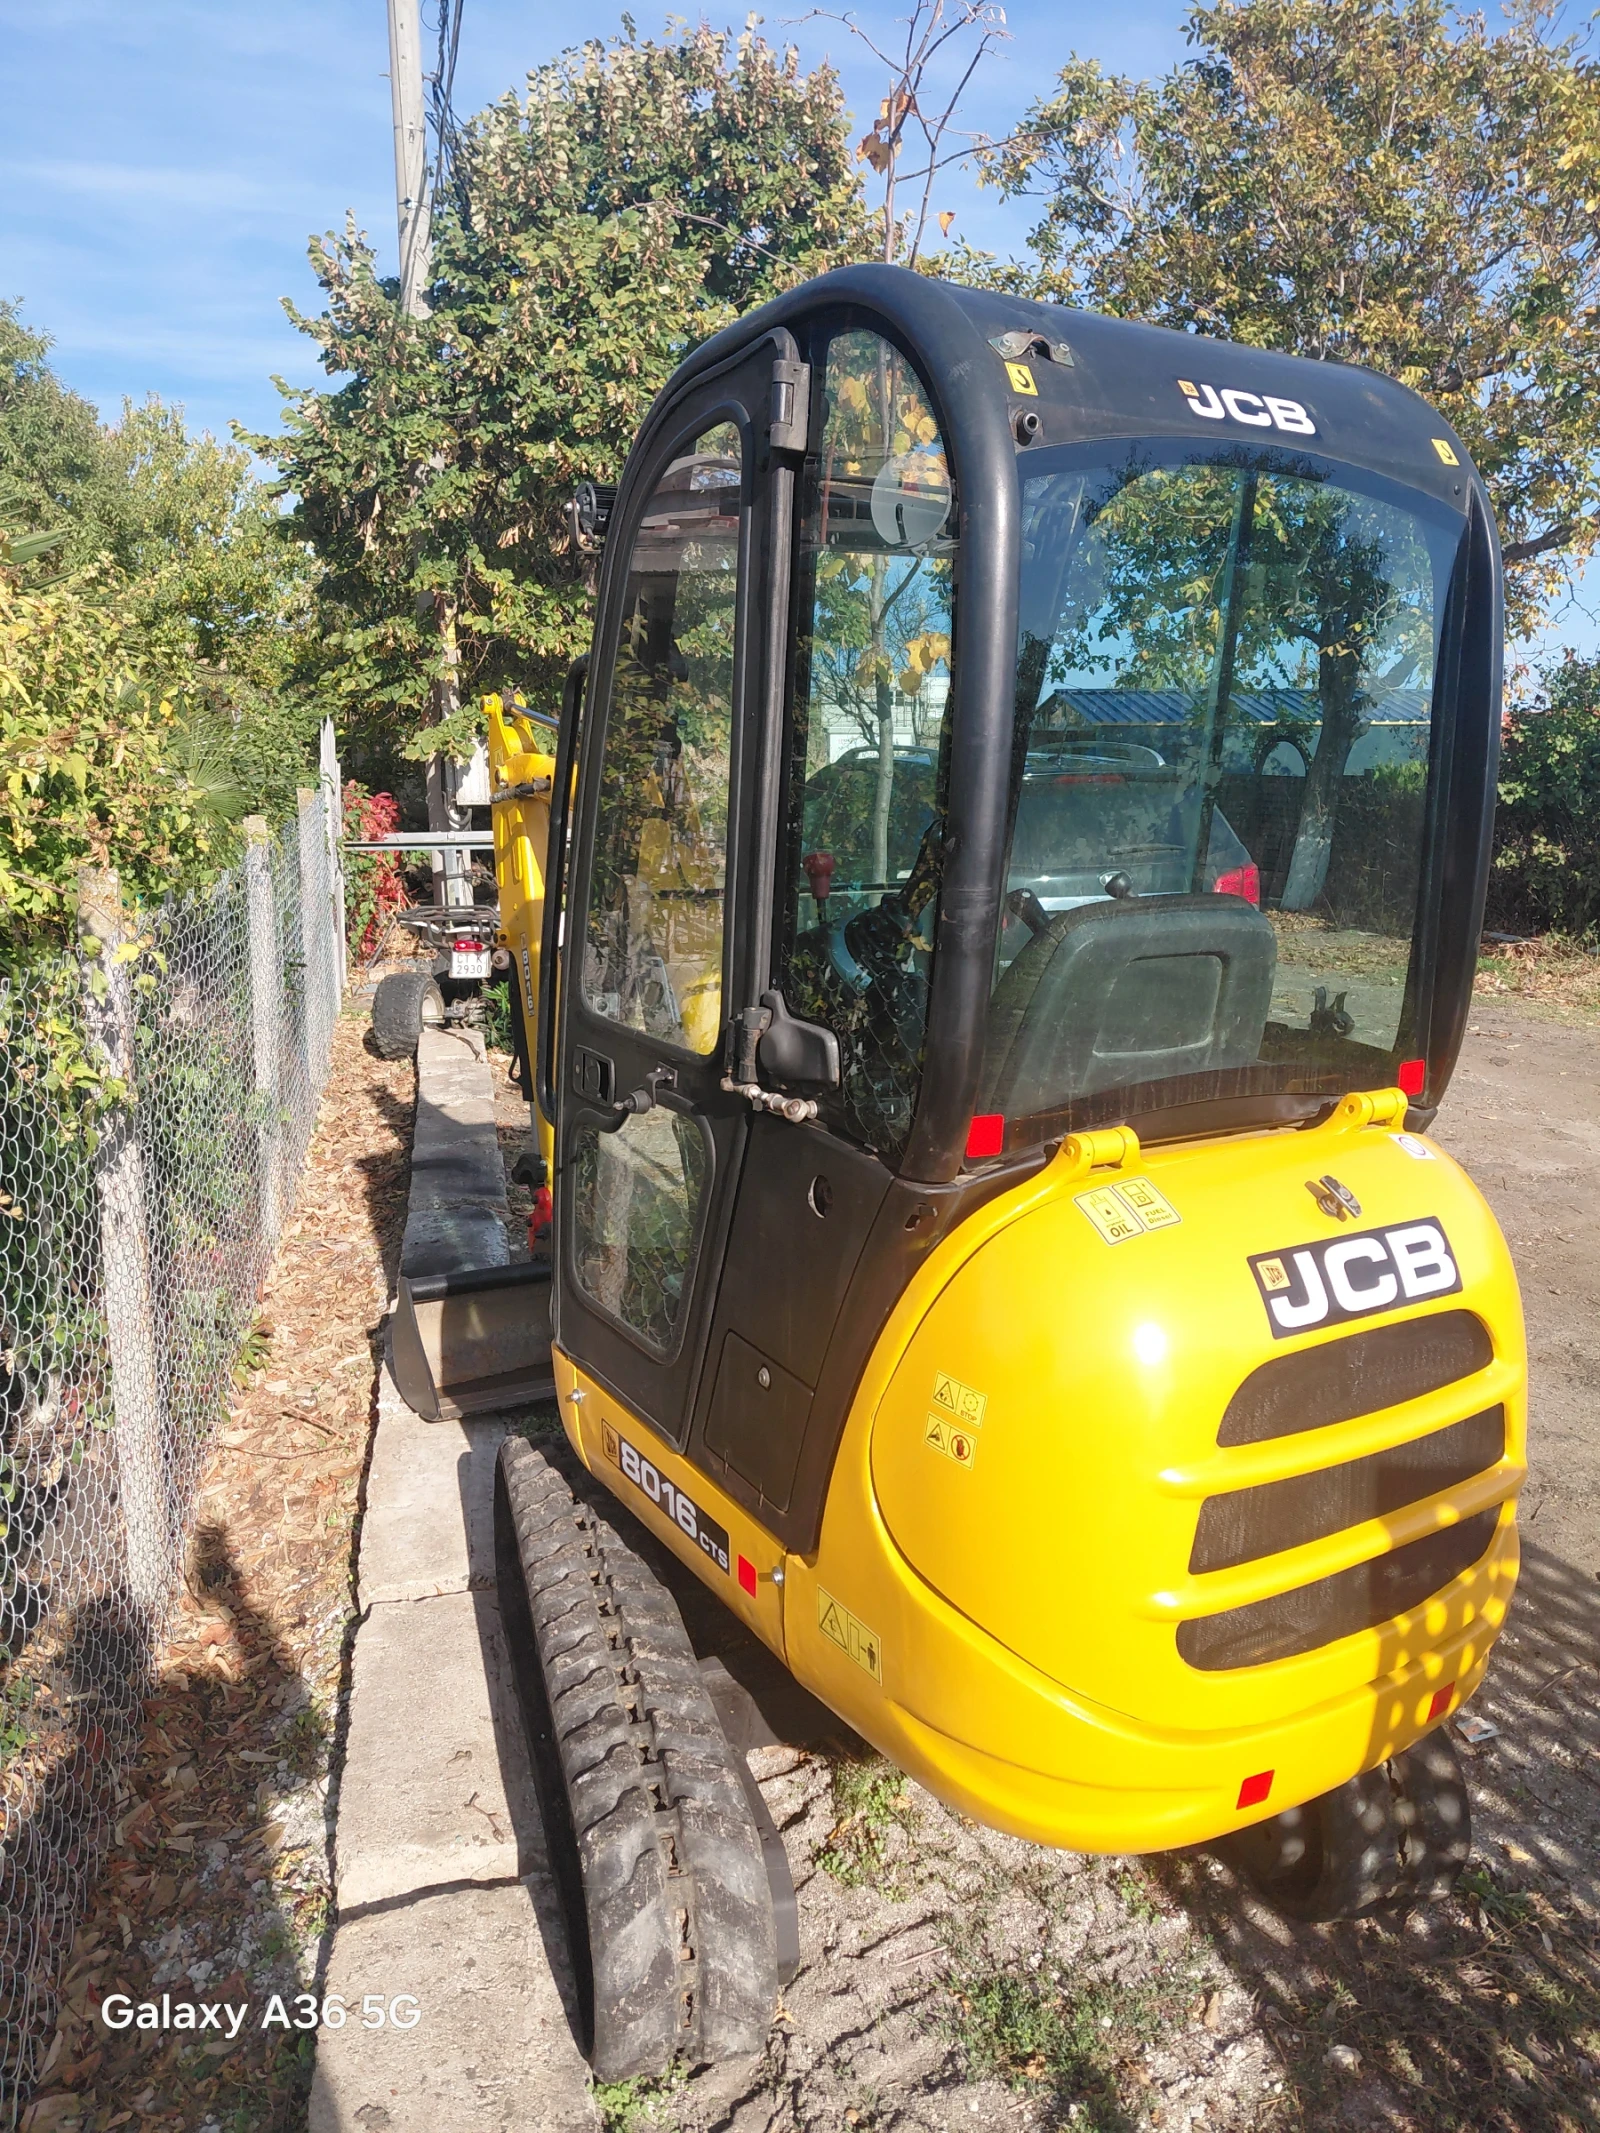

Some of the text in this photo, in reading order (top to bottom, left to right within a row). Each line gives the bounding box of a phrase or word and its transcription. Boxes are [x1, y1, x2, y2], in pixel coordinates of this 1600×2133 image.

[1187, 384, 1316, 434] JCB
[456, 964, 483, 975] 2930
[522, 950, 534, 1010] 8016
[1145, 1208, 1167, 1217] FUEL
[1148, 1213, 1173, 1224] Diesel
[1110, 1223, 1134, 1238] OIL
[1270, 1225, 1457, 1328] JCB
[960, 1409, 978, 1421] STOP
[621, 1441, 728, 1569] 8016 CTS
